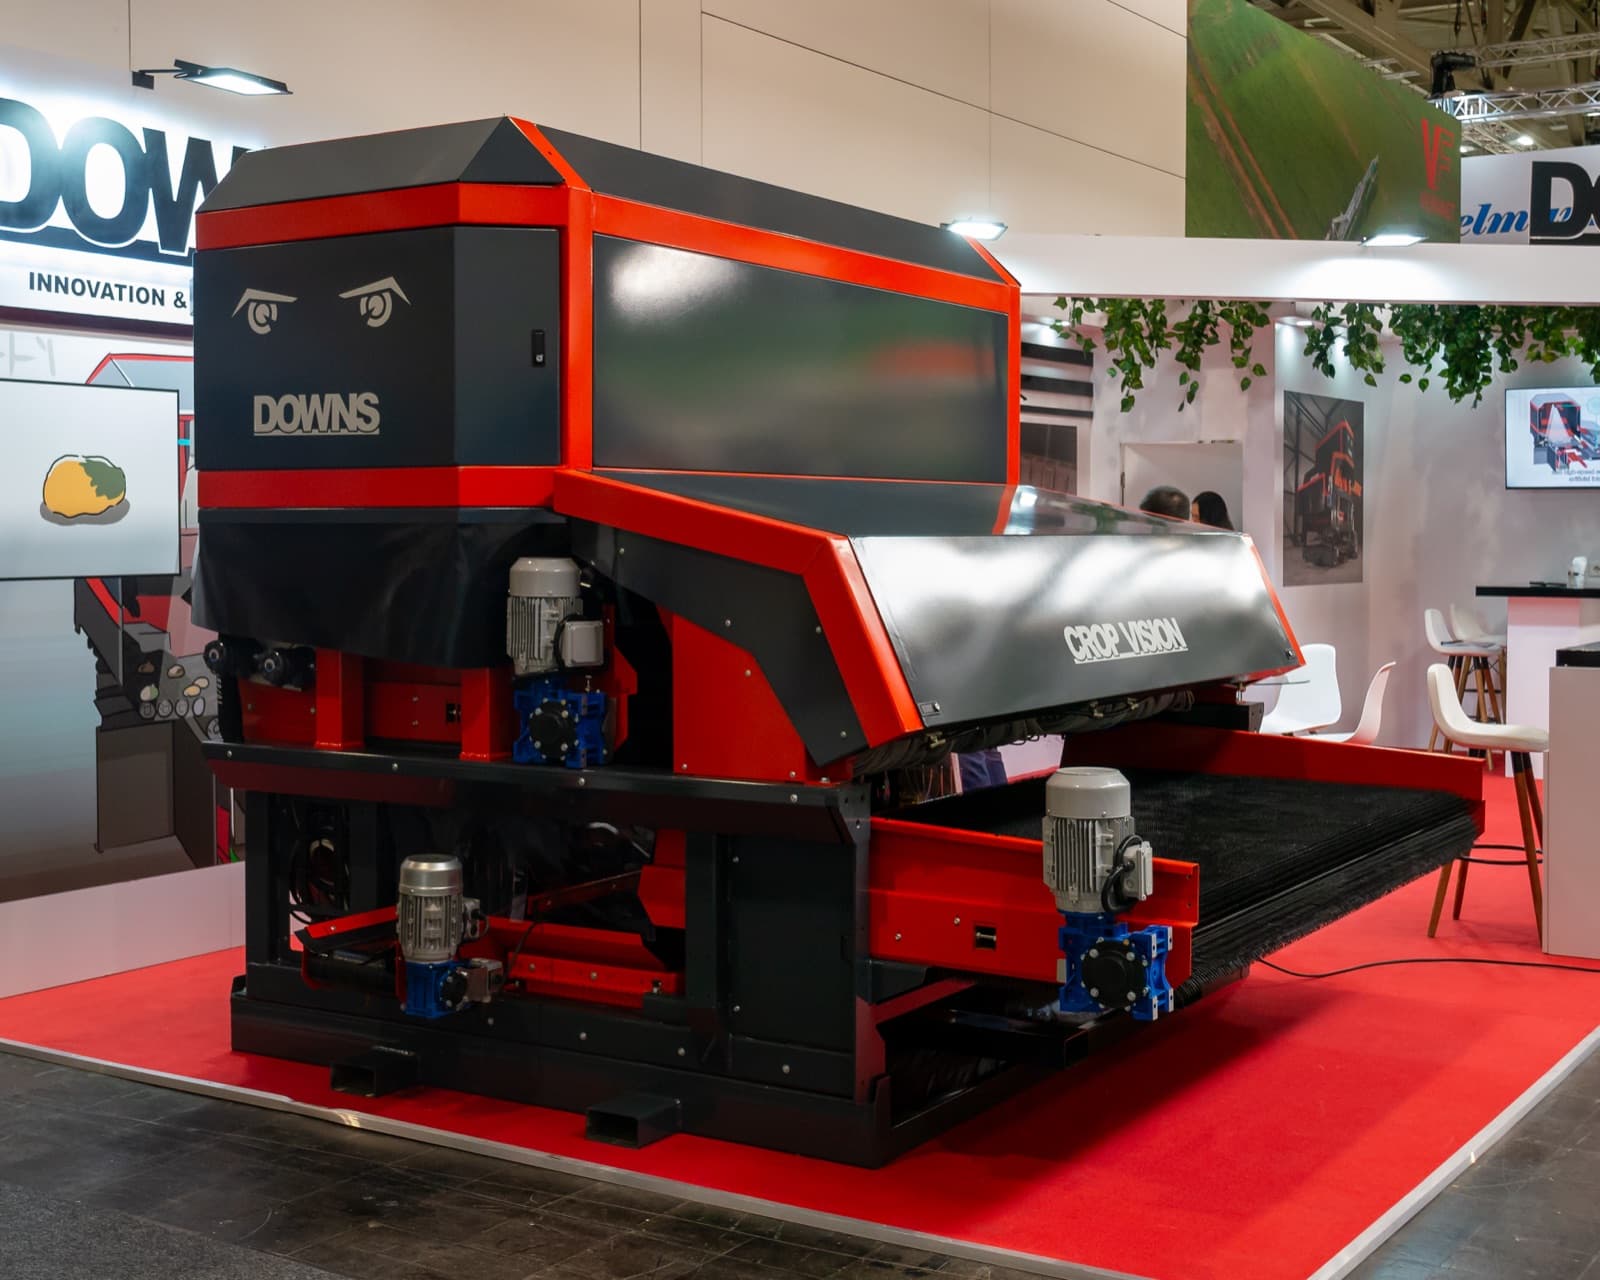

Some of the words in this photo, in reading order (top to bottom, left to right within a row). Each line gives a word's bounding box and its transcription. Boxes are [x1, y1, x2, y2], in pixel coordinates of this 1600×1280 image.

[1530, 161, 1600, 238] D
[29, 271, 165, 307] INNOVATION
[173, 290, 188, 309] &
[254, 392, 380, 434] DOWNS
[1064, 623, 1120, 661] CROP
[1118, 617, 1187, 655] VISION
